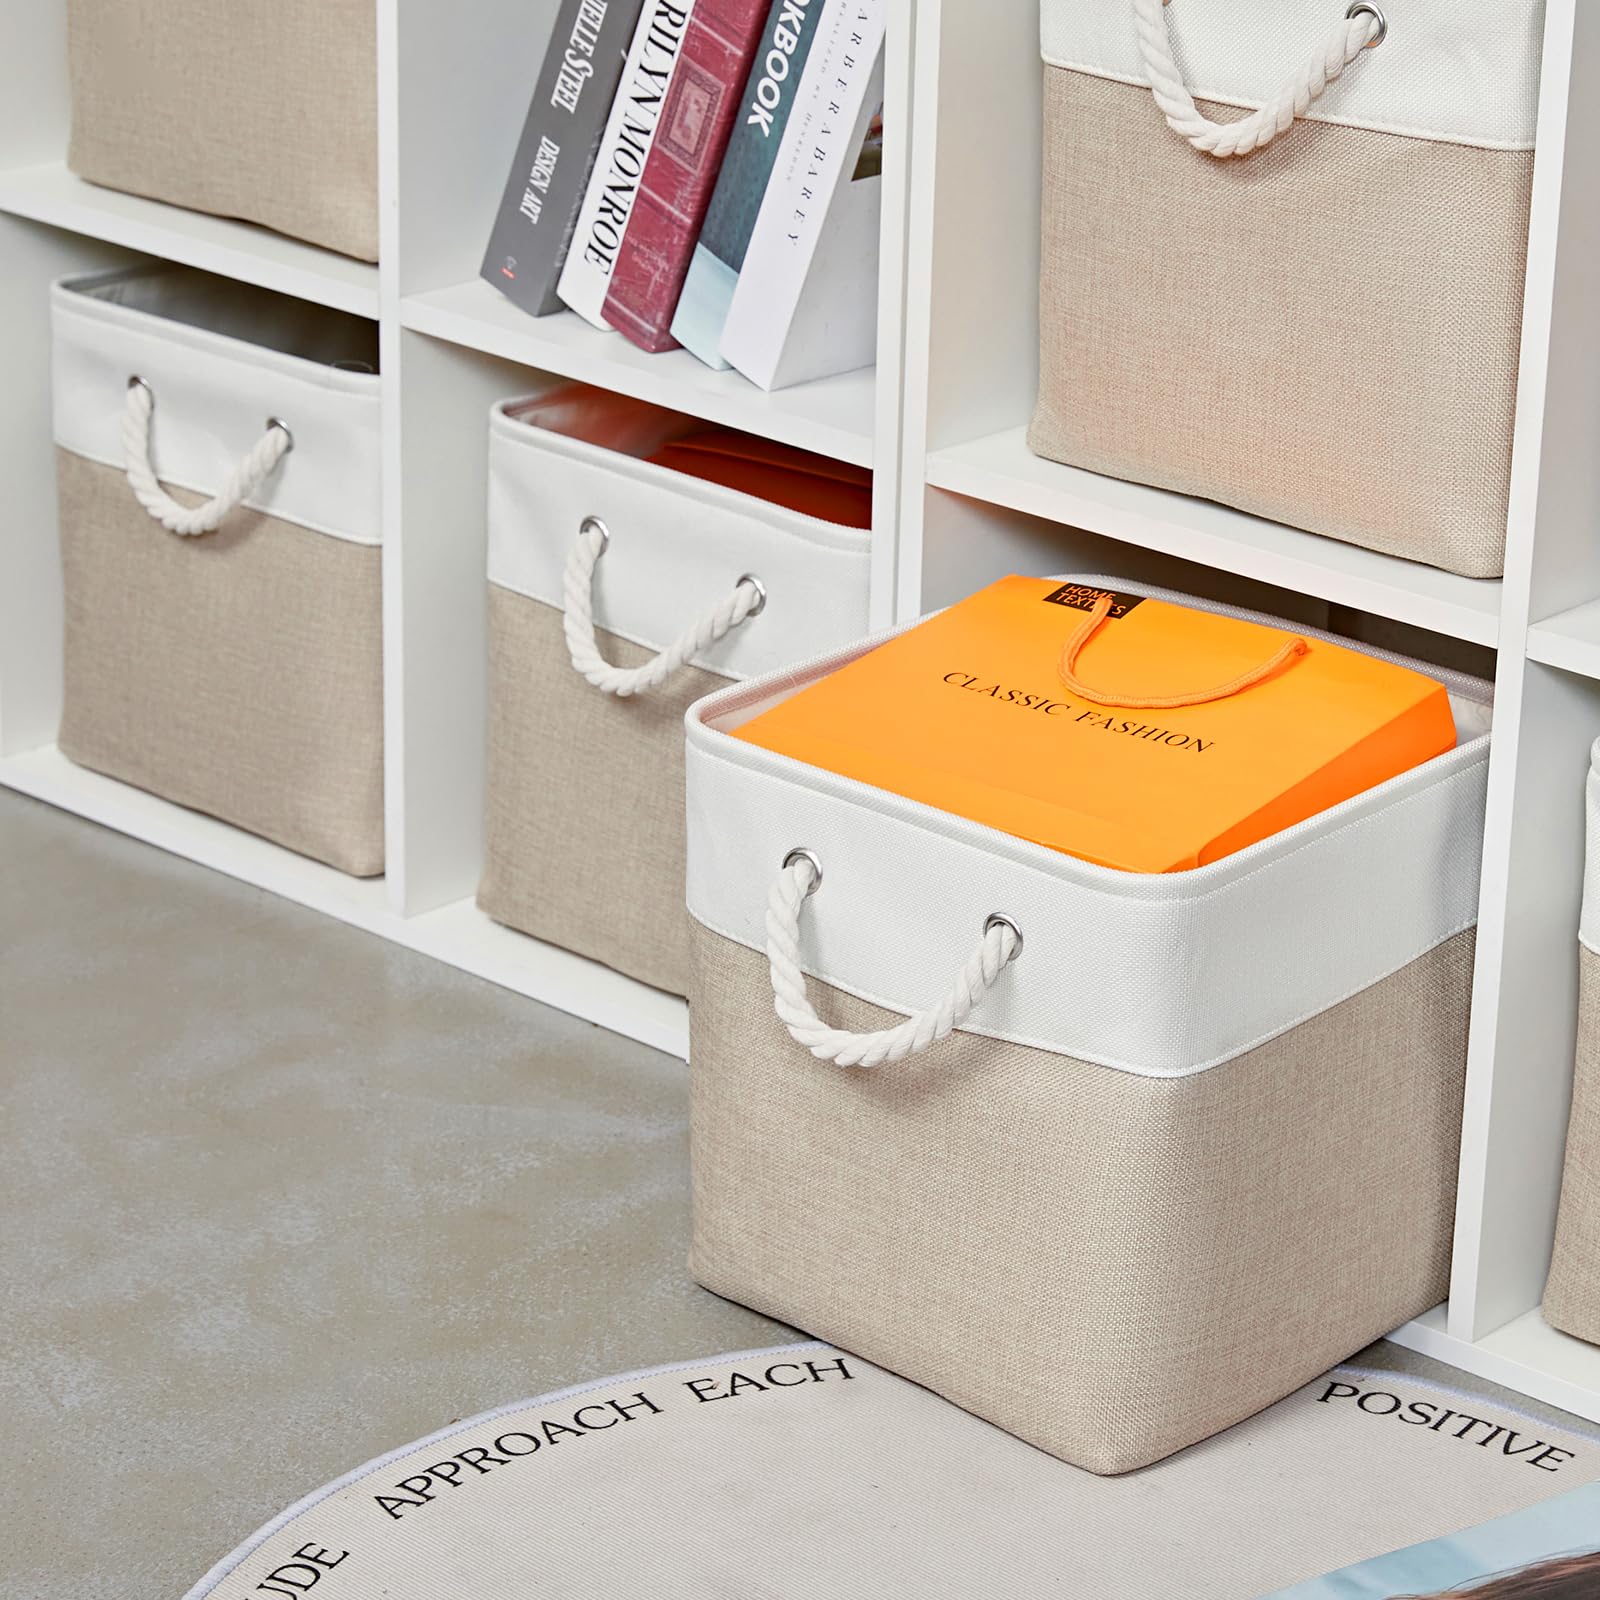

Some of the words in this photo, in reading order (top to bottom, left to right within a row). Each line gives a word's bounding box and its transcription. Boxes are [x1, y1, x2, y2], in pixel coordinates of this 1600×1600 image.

[550, 48, 595, 114] STEEL
[529, 135, 560, 194] DESIGN
[584, 111, 651, 276] MONROE
[519, 187, 543, 224] ART
[1056, 592, 1127, 615] TEXTS
[1065, 585, 1117, 599] HOME
[943, 671, 1071, 716] CLASSIC
[1074, 711, 1215, 753] FASHION
[373, 1391, 664, 1520] APPROACH
[683, 1357, 855, 1403] EACH
[1316, 1380, 1576, 1472] POSITIVE
